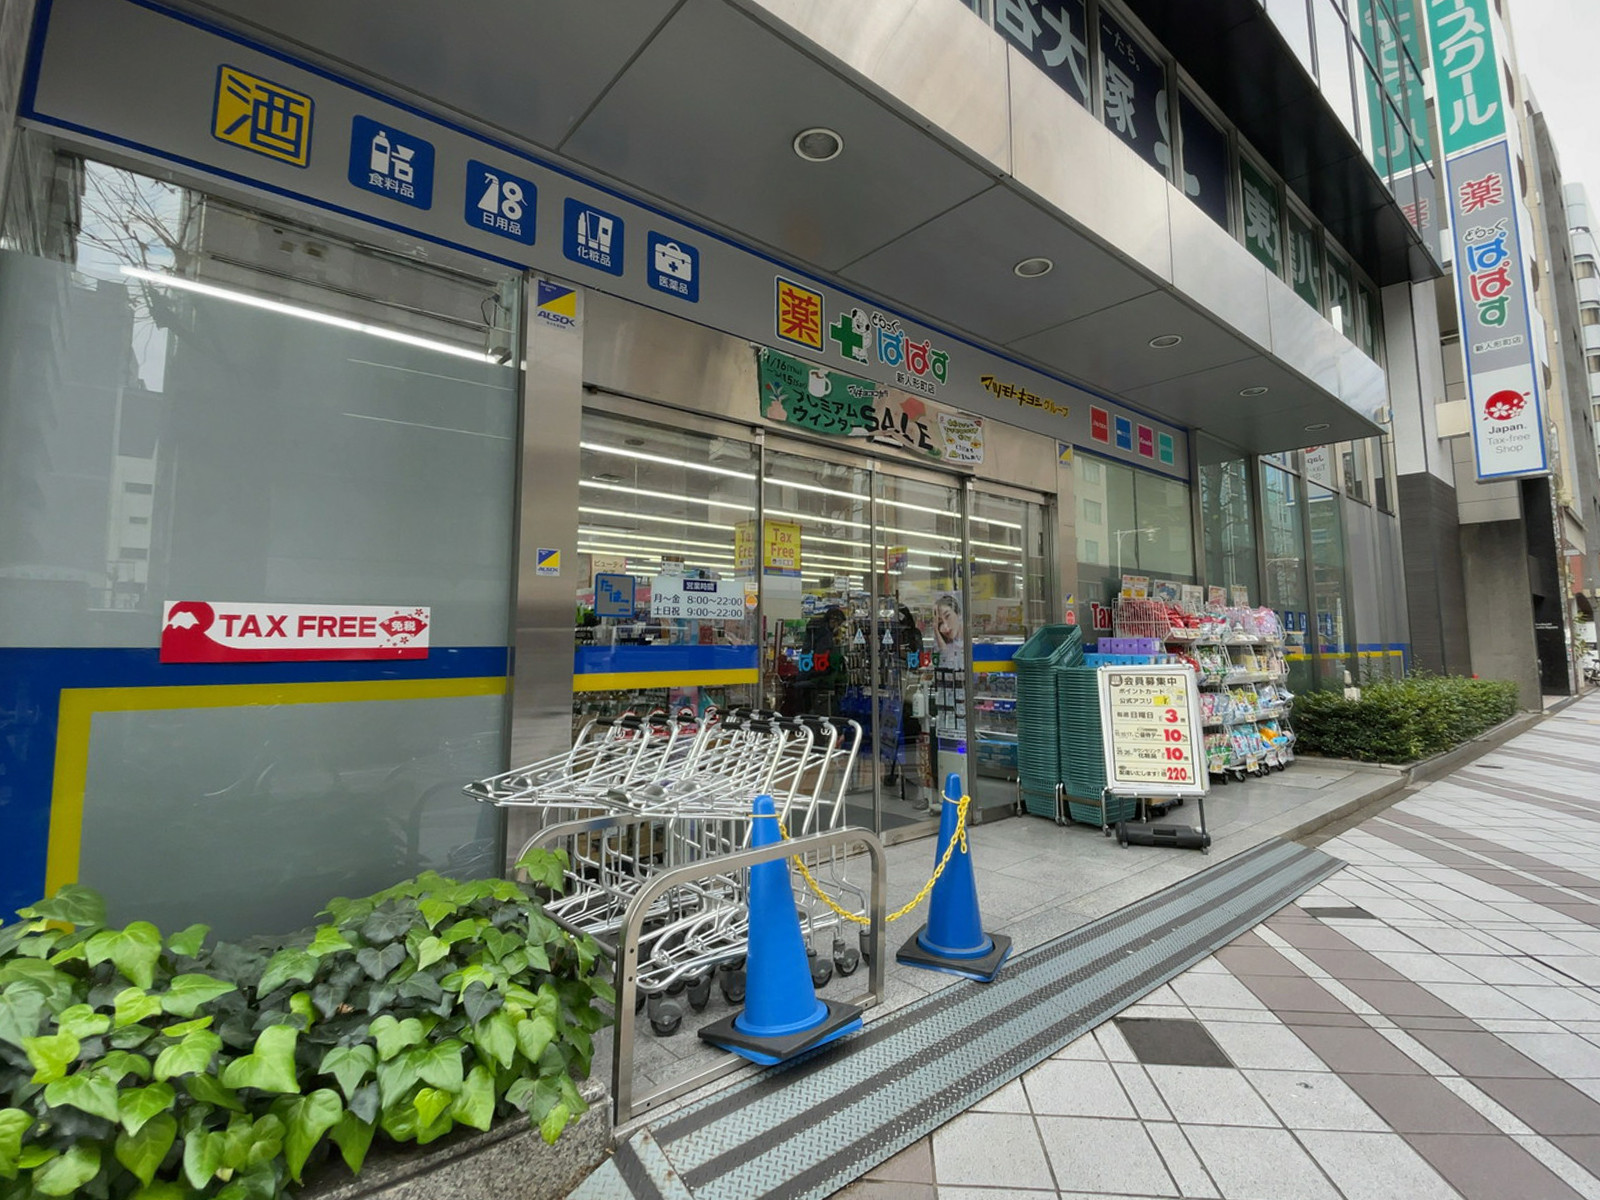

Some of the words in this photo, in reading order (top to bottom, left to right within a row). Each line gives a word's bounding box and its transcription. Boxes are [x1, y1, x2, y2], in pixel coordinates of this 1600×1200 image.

[223, 74, 305, 159] 酒
[369, 173, 414, 198] 食料品
[1460, 174, 1502, 214] 薬
[482, 212, 522, 235] 日用品
[577, 246, 611, 267] 化粧品
[658, 275, 689, 295] 医薬品
[1467, 231, 1511, 326] ぱぱす
[538, 310, 576, 327] ALSOK
[781, 287, 819, 343] 薬
[878, 327, 949, 384] ぱぱす
[896, 372, 935, 394] 新人形町店
[793, 389, 858, 418] プレミアム
[860, 405, 934, 450] SALE
[1495, 445, 1524, 454] Shop
[740, 529, 753, 543] Ta
[772, 528, 793, 543] Tax
[739, 545, 753, 558] Fre
[771, 542, 795, 558] Free
[685, 581, 715, 591] 営業時間
[654, 606, 680, 616] 土日祝
[219, 614, 287, 638] TAX
[297, 616, 377, 638] FREE
[391, 620, 416, 632] 免税
[1124, 677, 1177, 687] 会員募集中
